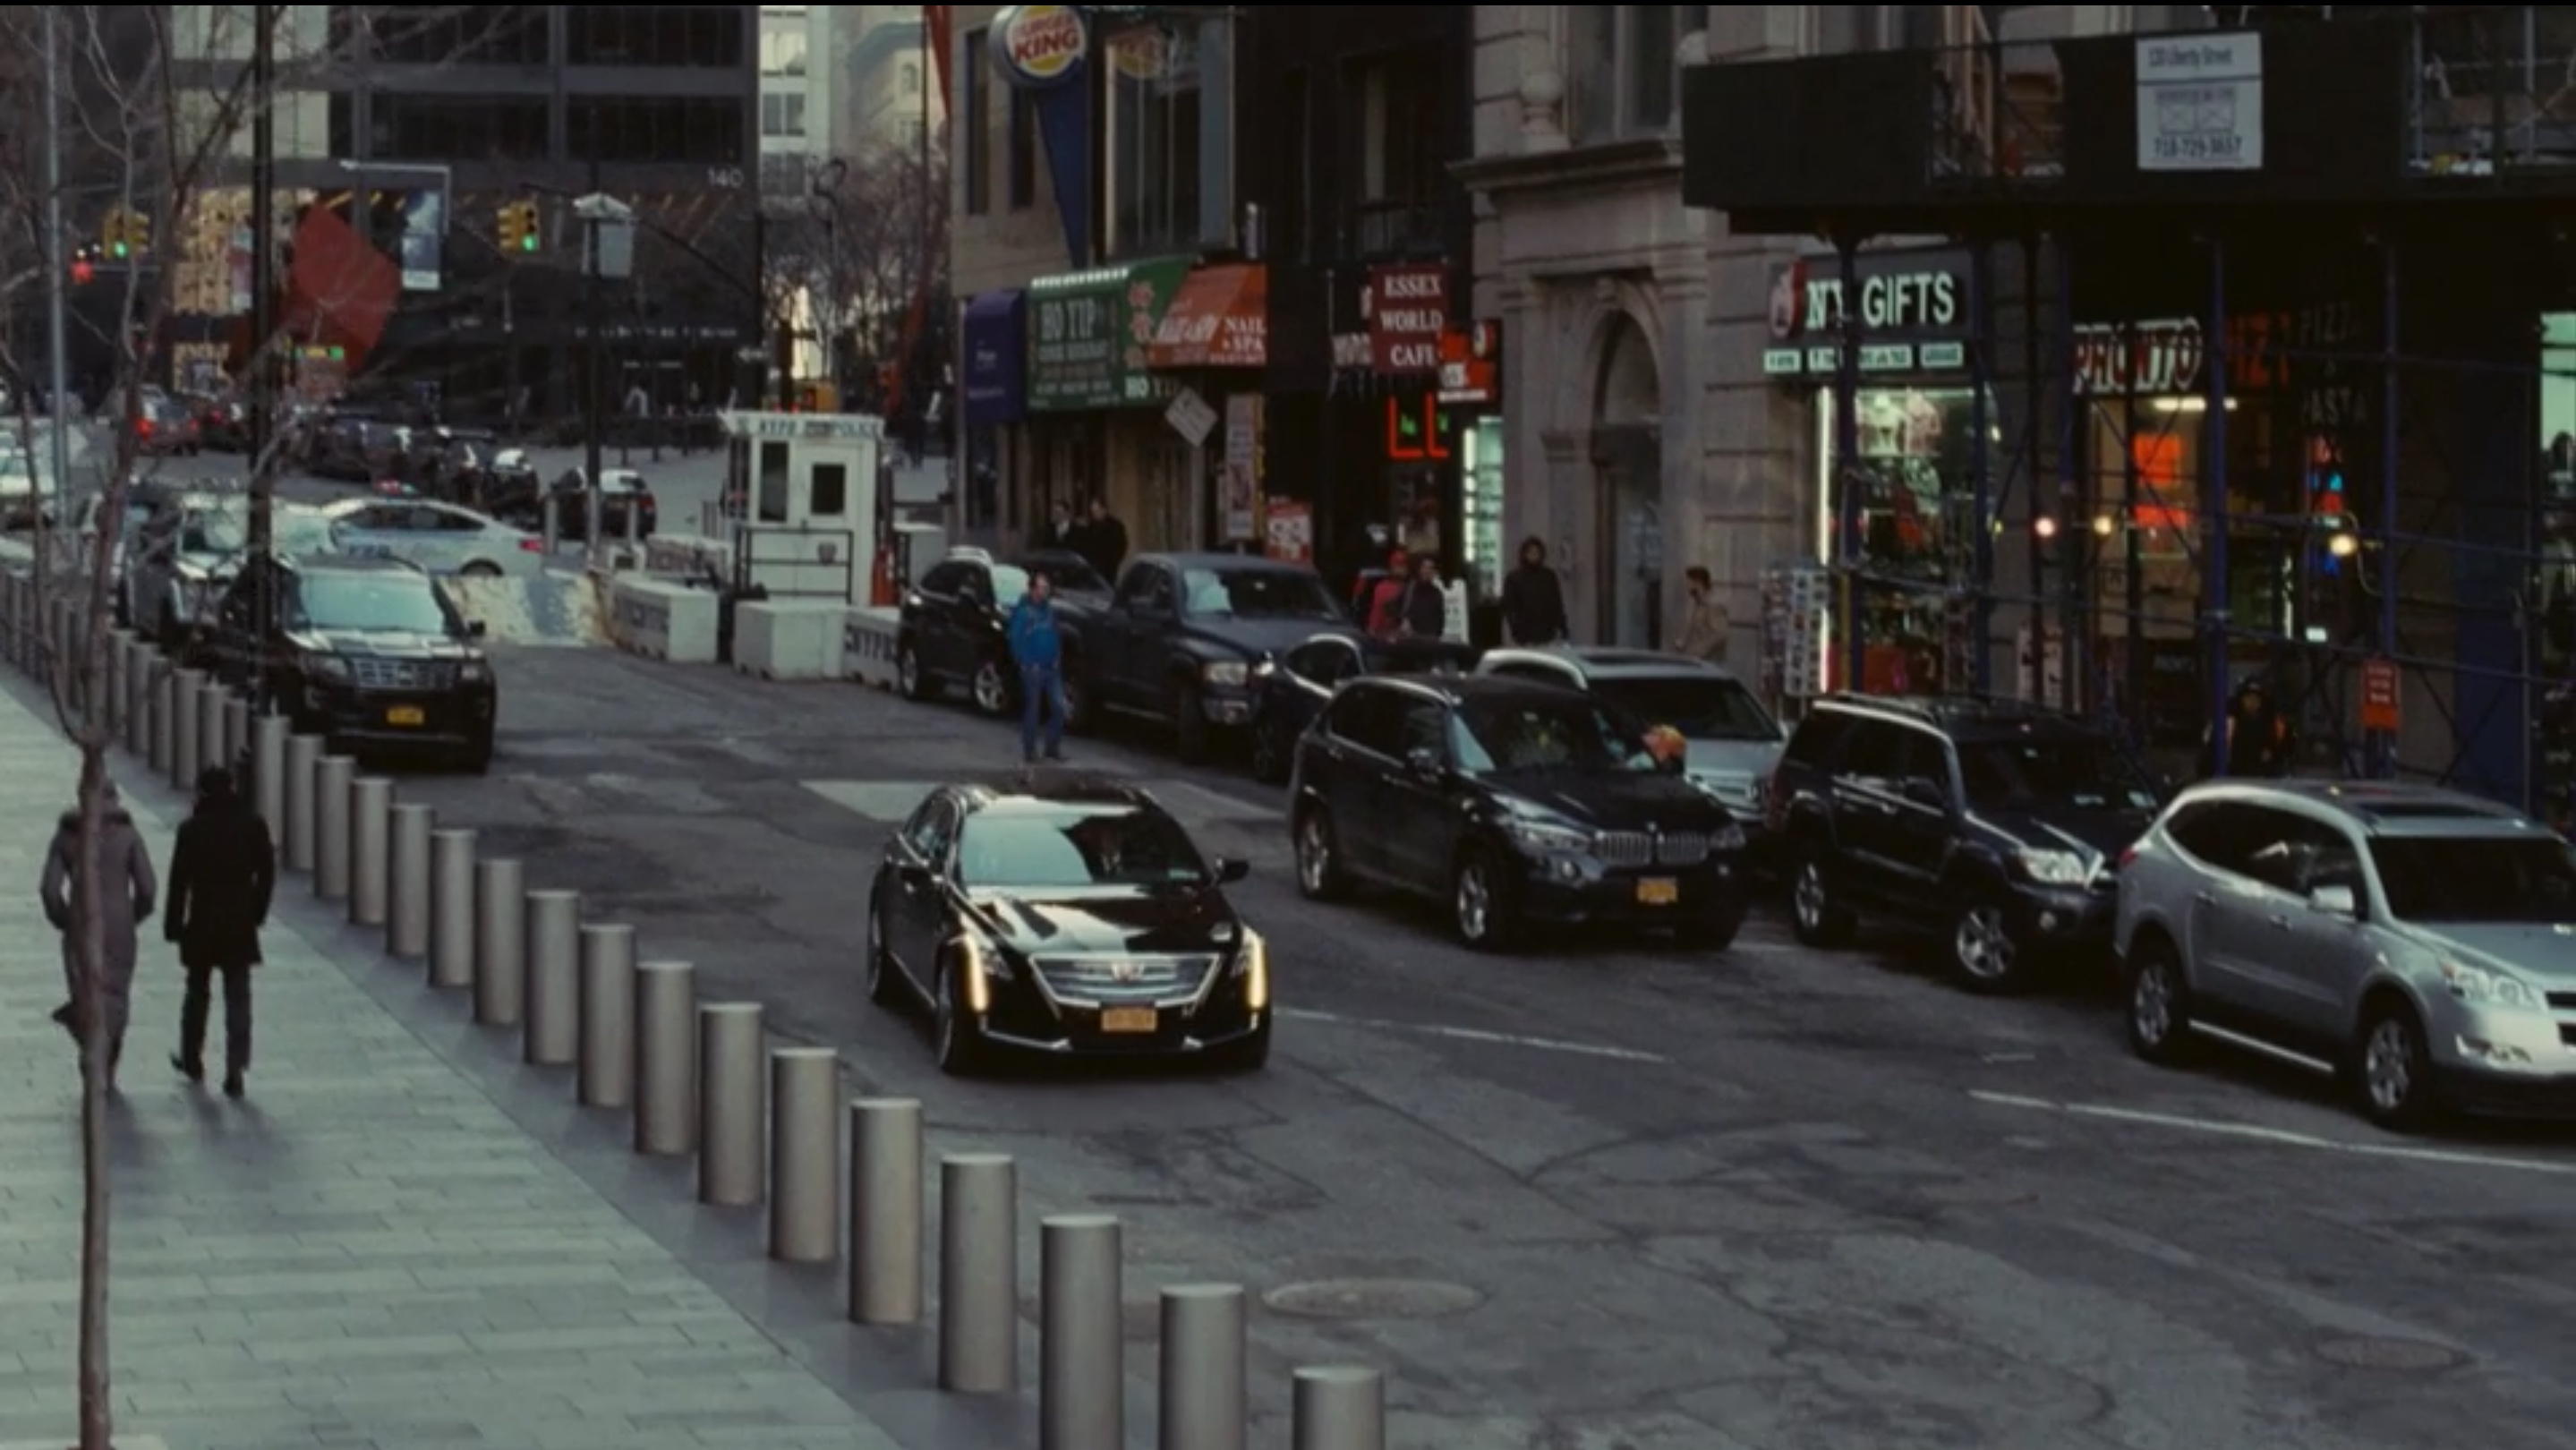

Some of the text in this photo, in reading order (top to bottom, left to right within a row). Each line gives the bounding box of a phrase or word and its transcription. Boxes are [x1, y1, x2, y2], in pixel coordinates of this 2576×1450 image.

[1015, 29, 1079, 63] KING
[706, 166, 744, 189] 140
[1384, 274, 1442, 299] ESSEX
[1862, 270, 1956, 328] GIFTS
[1224, 316, 1267, 337] NAIL
[1379, 309, 1445, 332] WORLD
[1233, 335, 1265, 353] SPA
